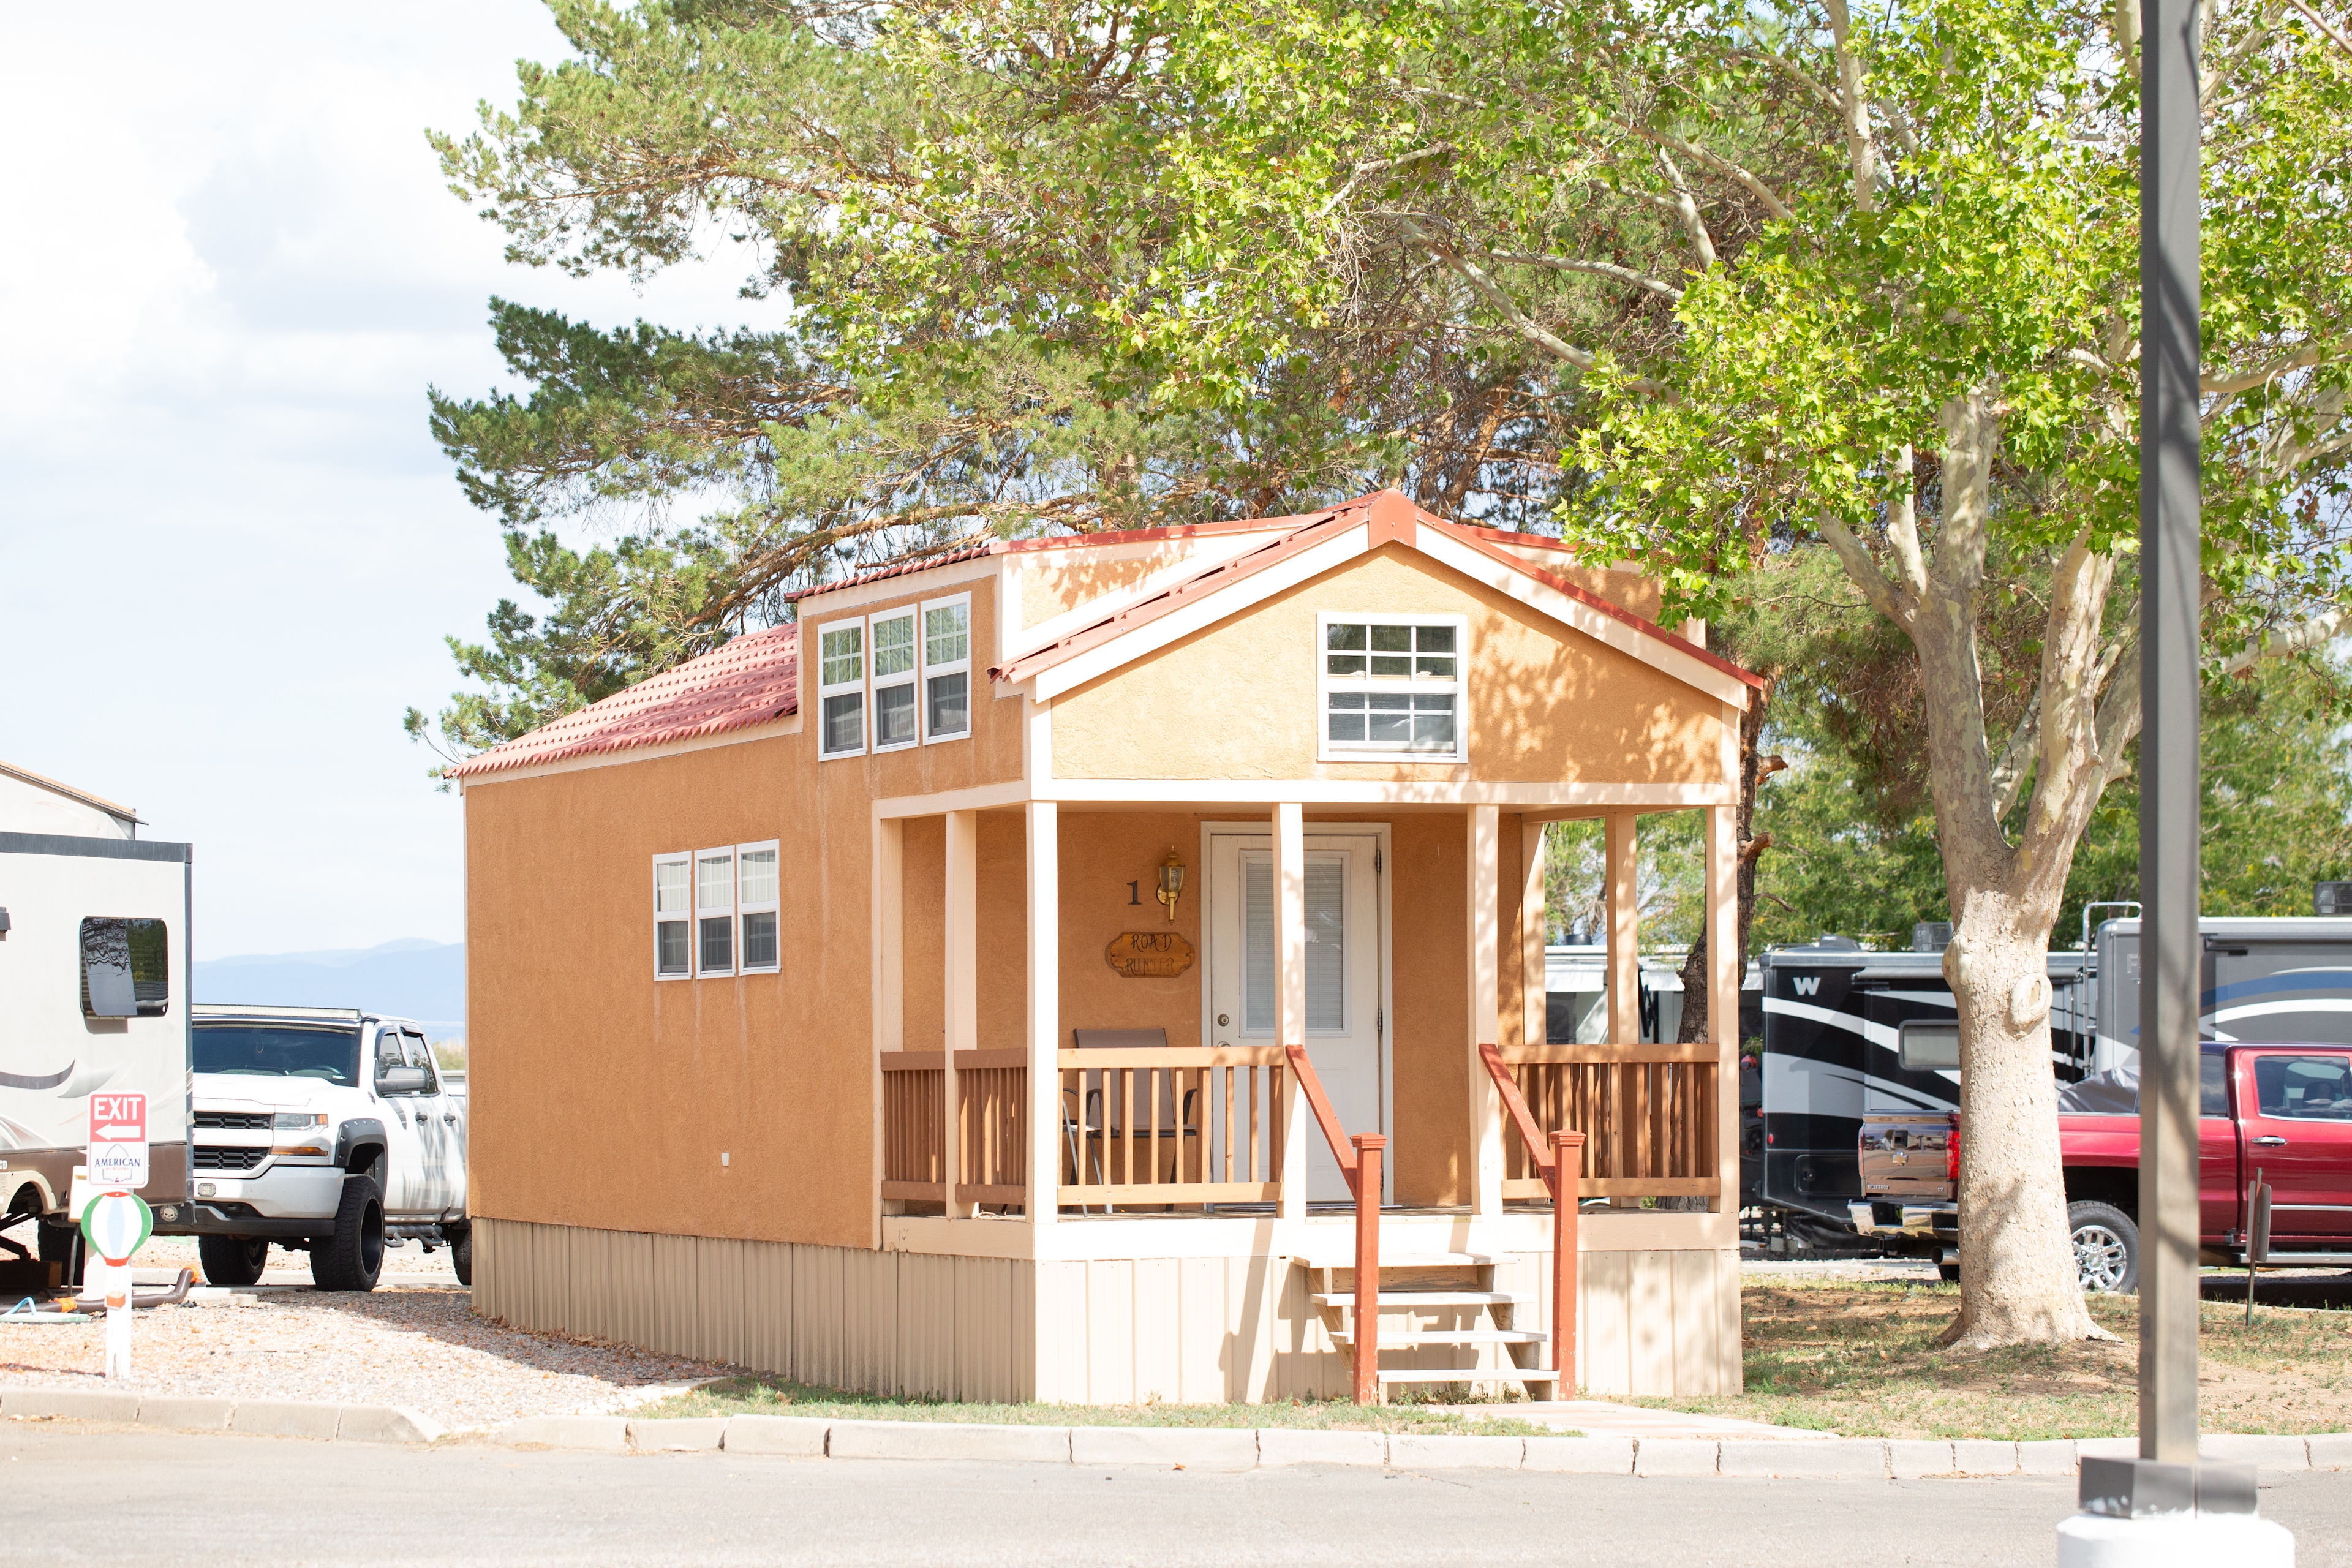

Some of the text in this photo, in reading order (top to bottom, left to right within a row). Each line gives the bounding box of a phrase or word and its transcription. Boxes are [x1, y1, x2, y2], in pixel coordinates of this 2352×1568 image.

[1126, 880, 1142, 905] 1
[1131, 934, 1172, 952] ROAD
[1792, 976, 1821, 995] W
[94, 1097, 141, 1120] EXIT
[94, 1158, 140, 1167] AMERICAN
